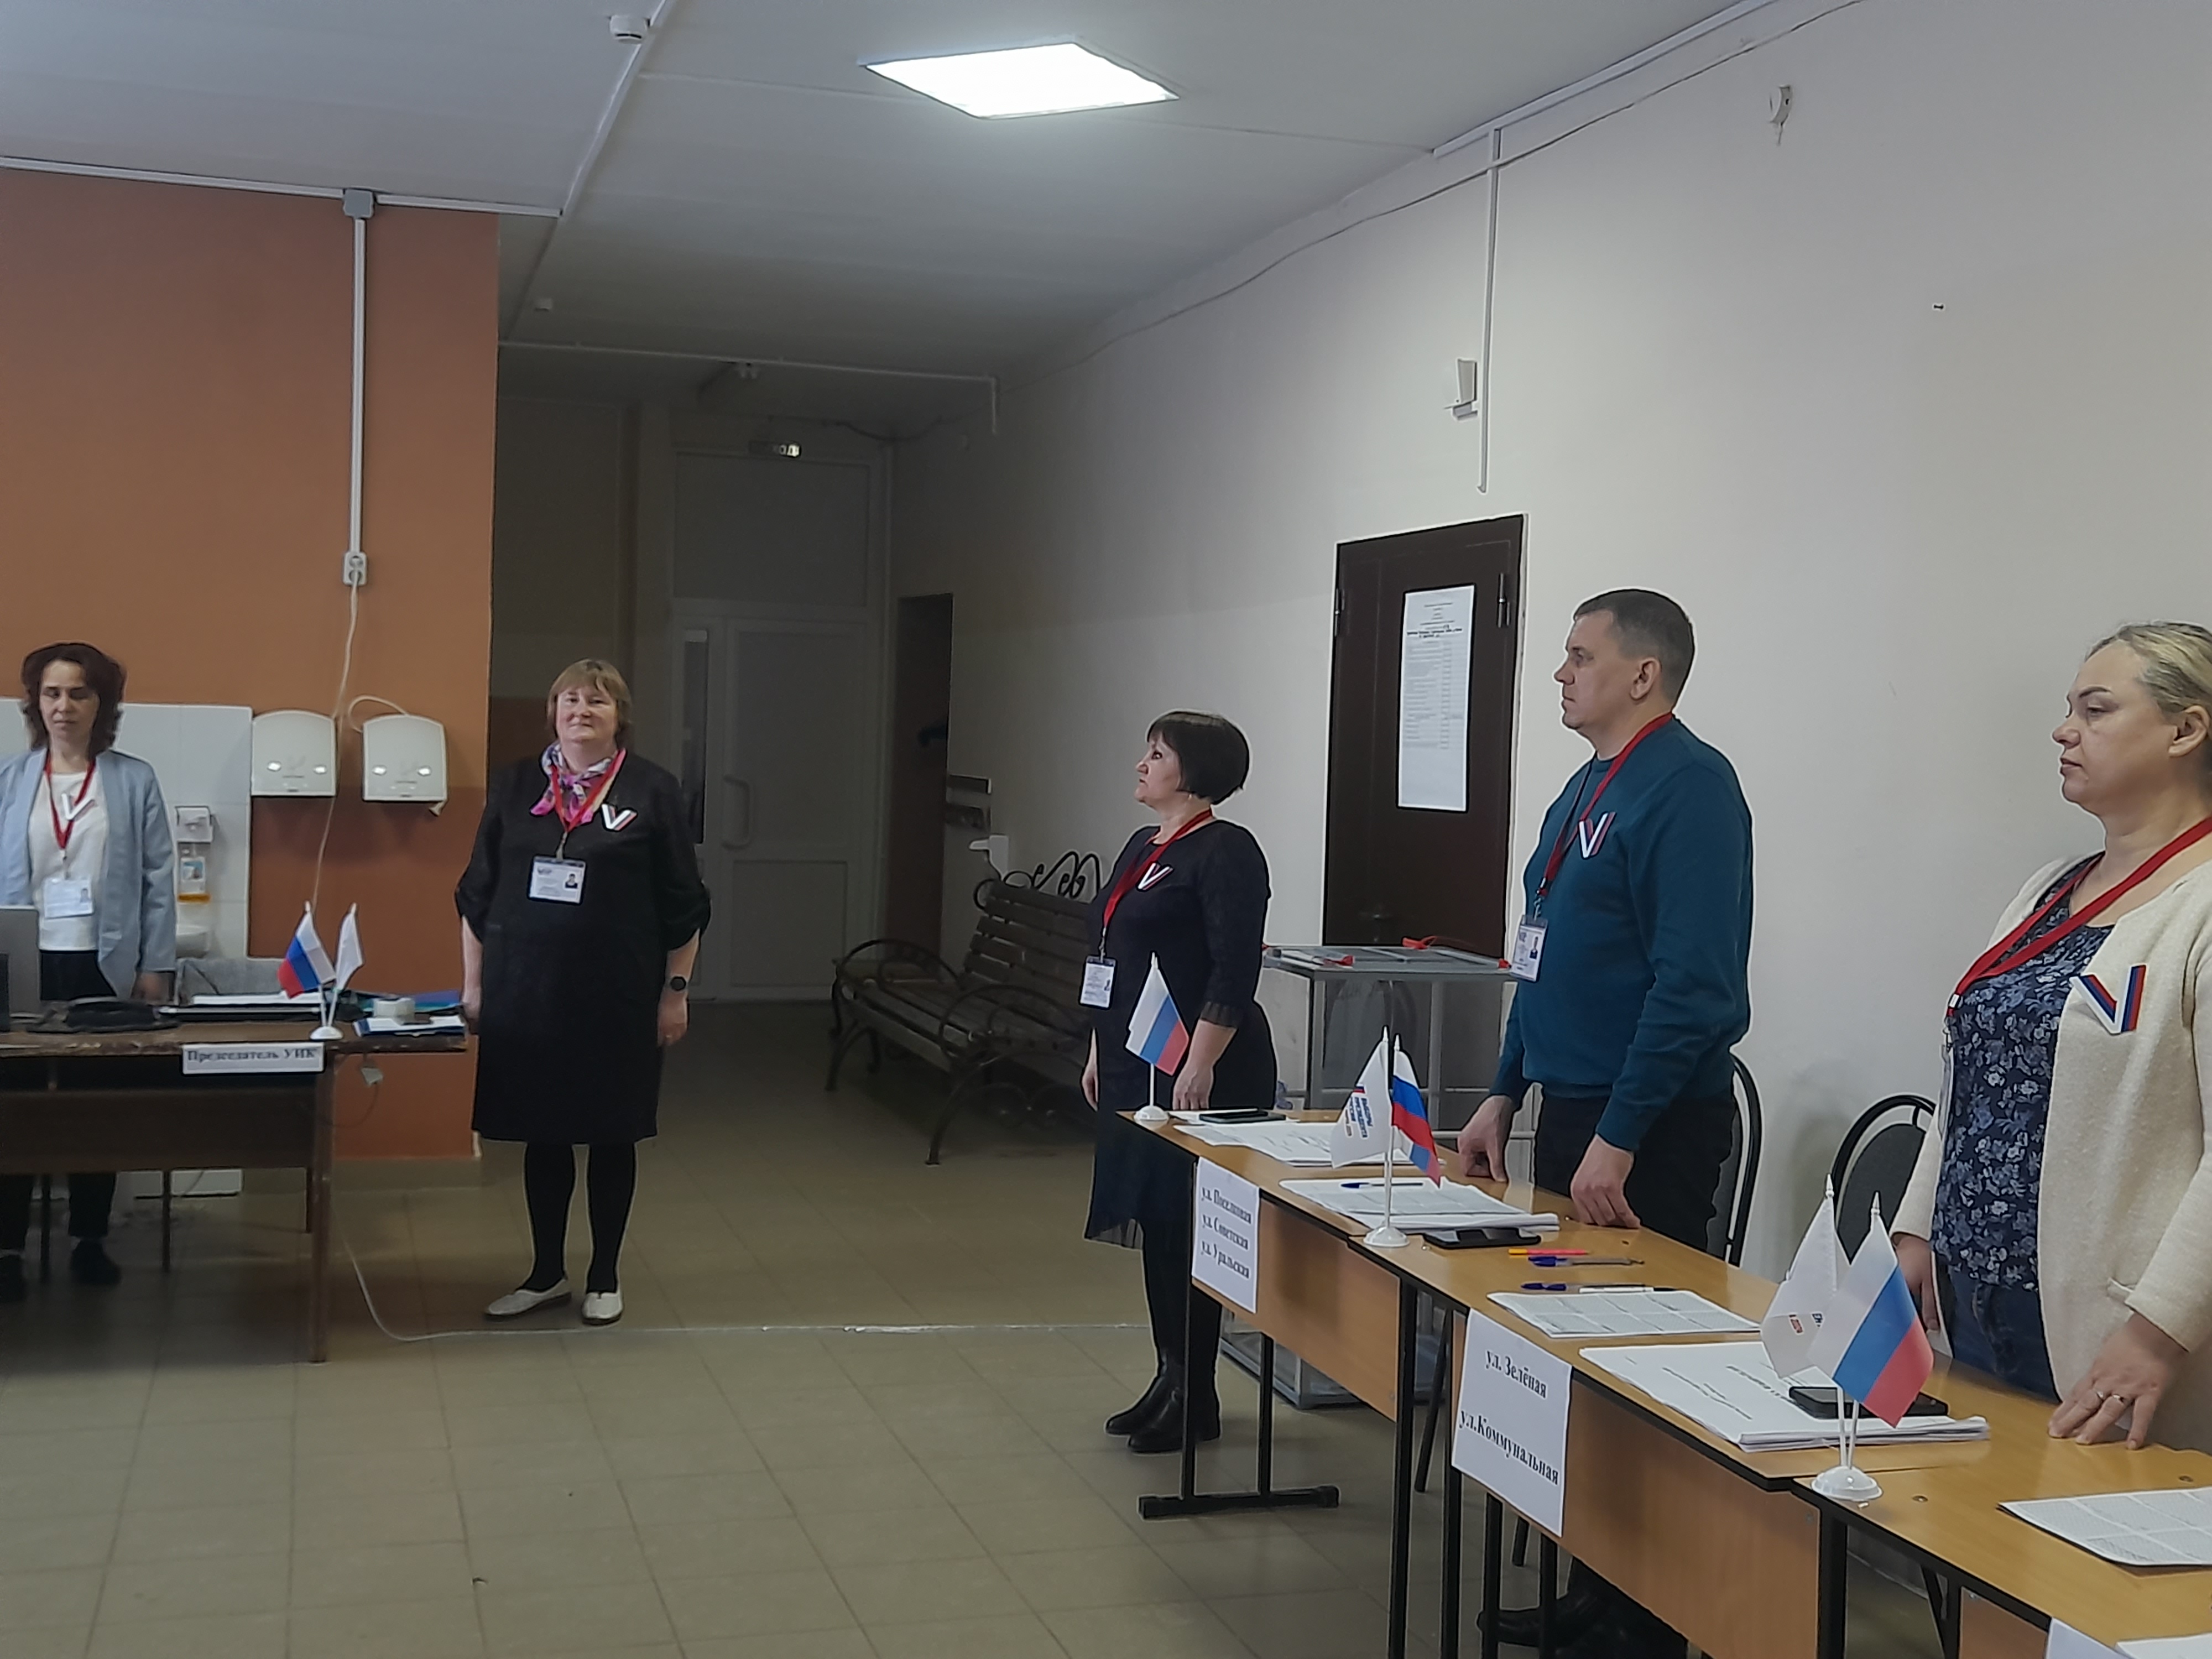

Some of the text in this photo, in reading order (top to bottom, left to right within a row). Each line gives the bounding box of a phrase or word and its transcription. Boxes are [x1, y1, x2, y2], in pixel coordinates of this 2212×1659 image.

[187, 1050, 278, 1062] Председатель
[1485, 1350, 1547, 1399] ул. Зелёная
